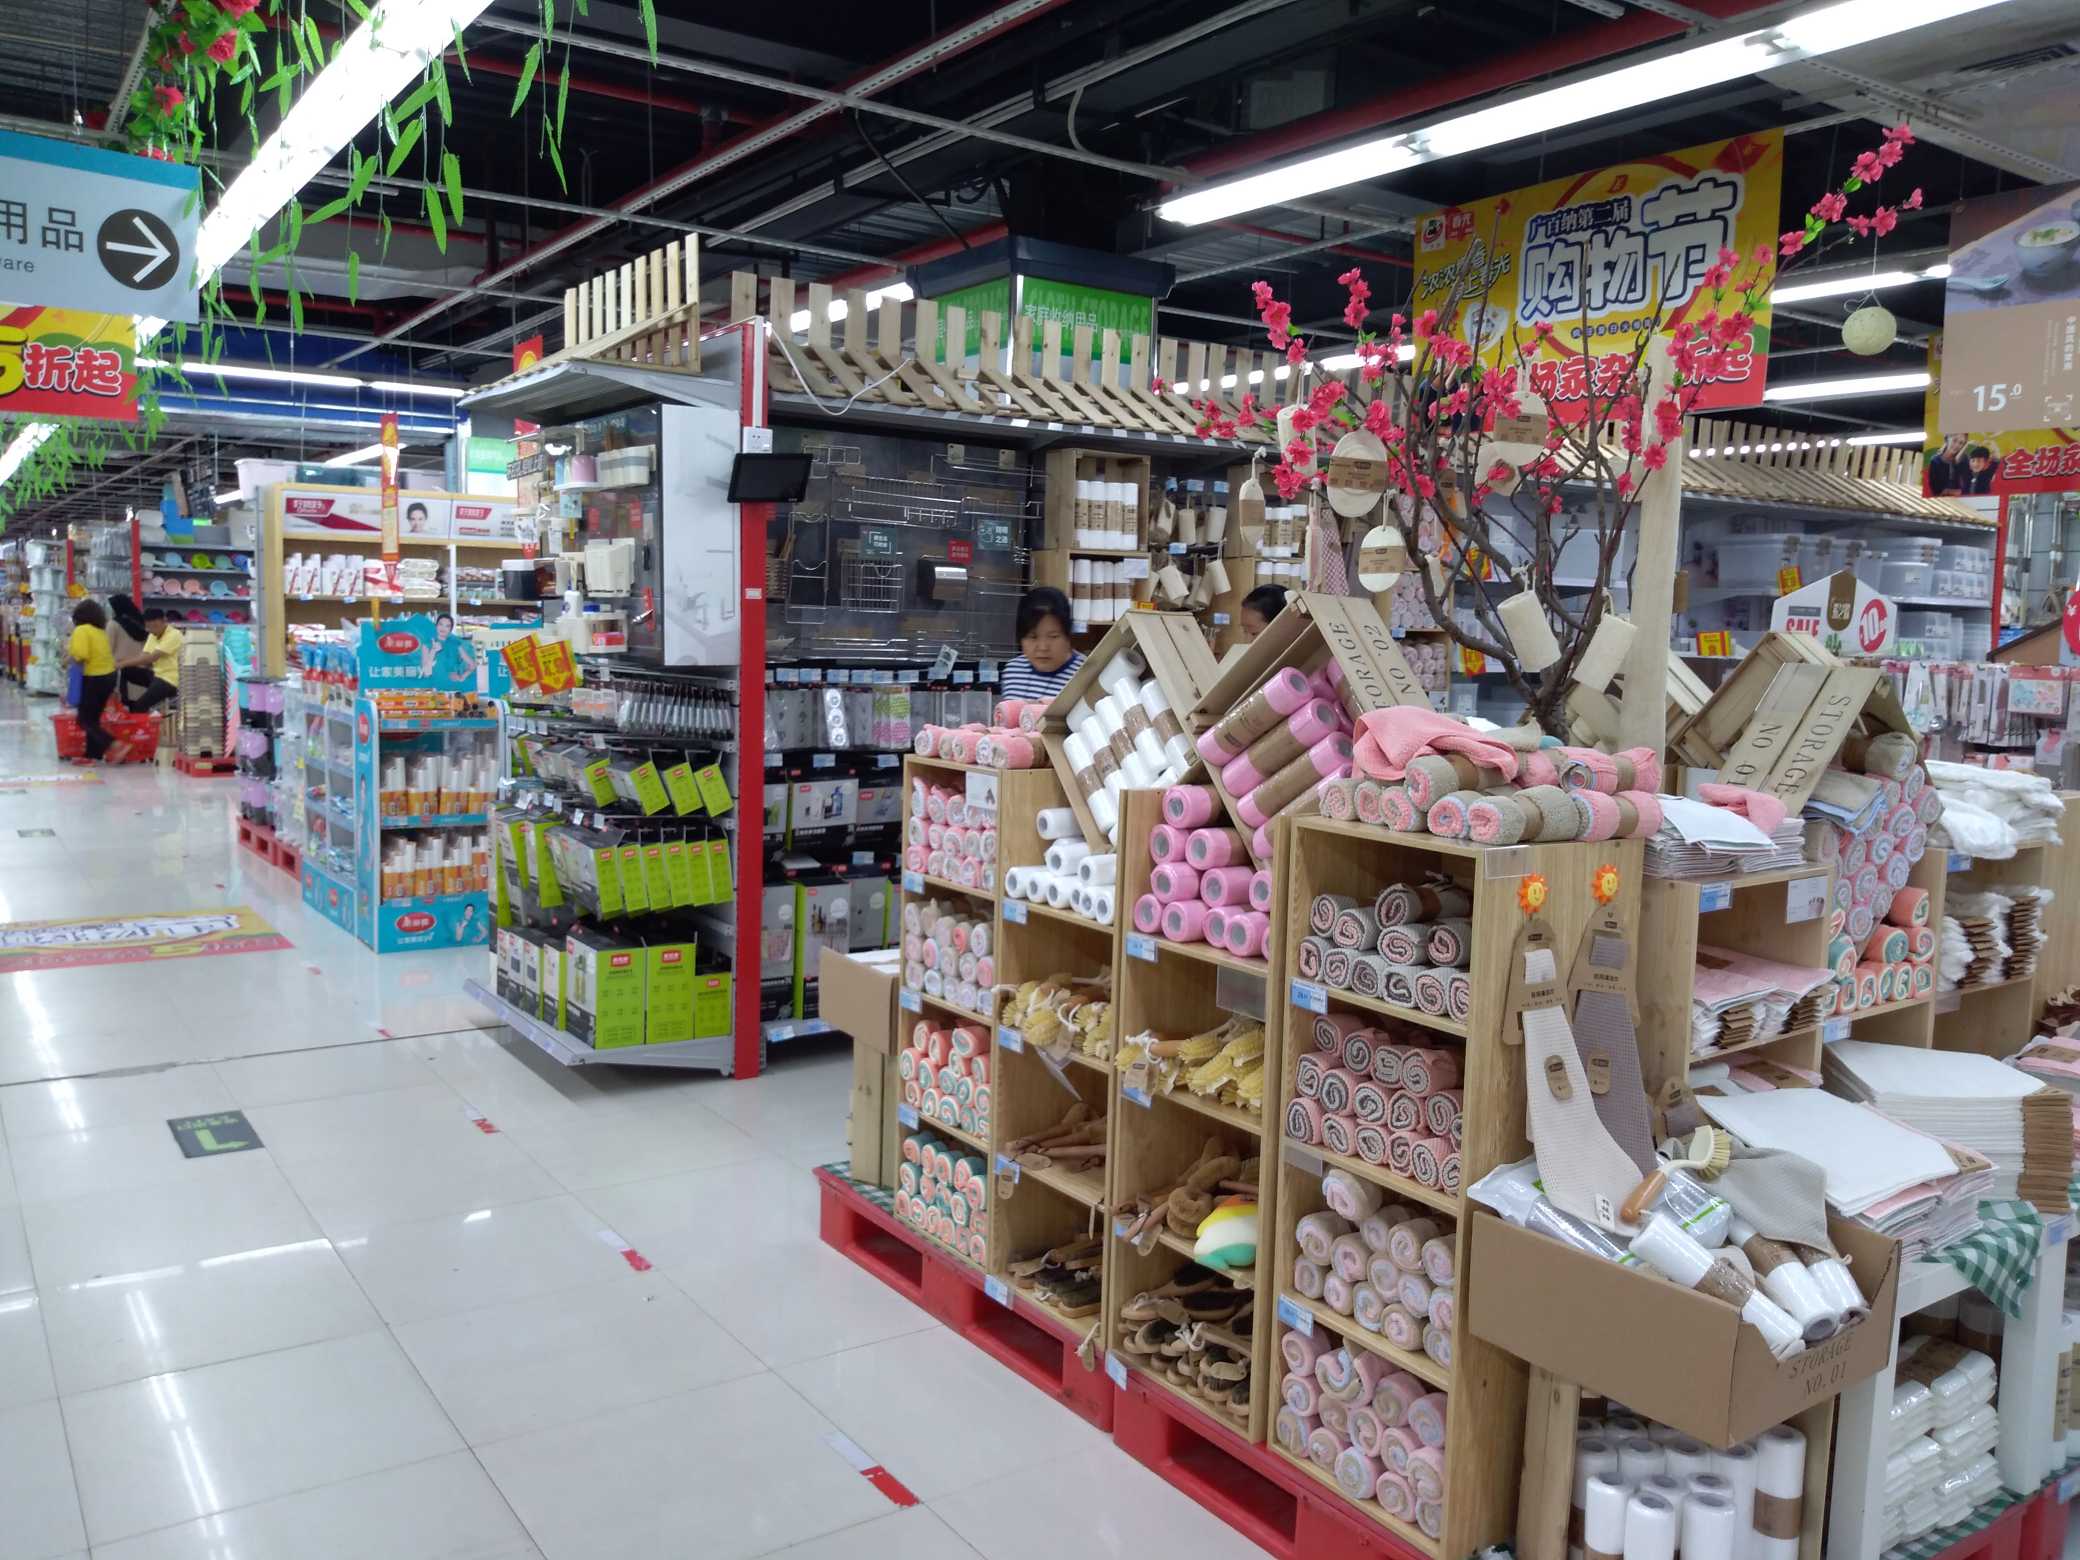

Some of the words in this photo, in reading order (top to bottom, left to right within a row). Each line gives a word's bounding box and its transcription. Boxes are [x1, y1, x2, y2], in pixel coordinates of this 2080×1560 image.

[0, 199, 84, 253] 用品
[0, 257, 34, 273] are
[1523, 176, 1738, 322] 购物节
[1329, 622, 1392, 709] TORAGE
[1773, 695, 1852, 794] STORAGE
